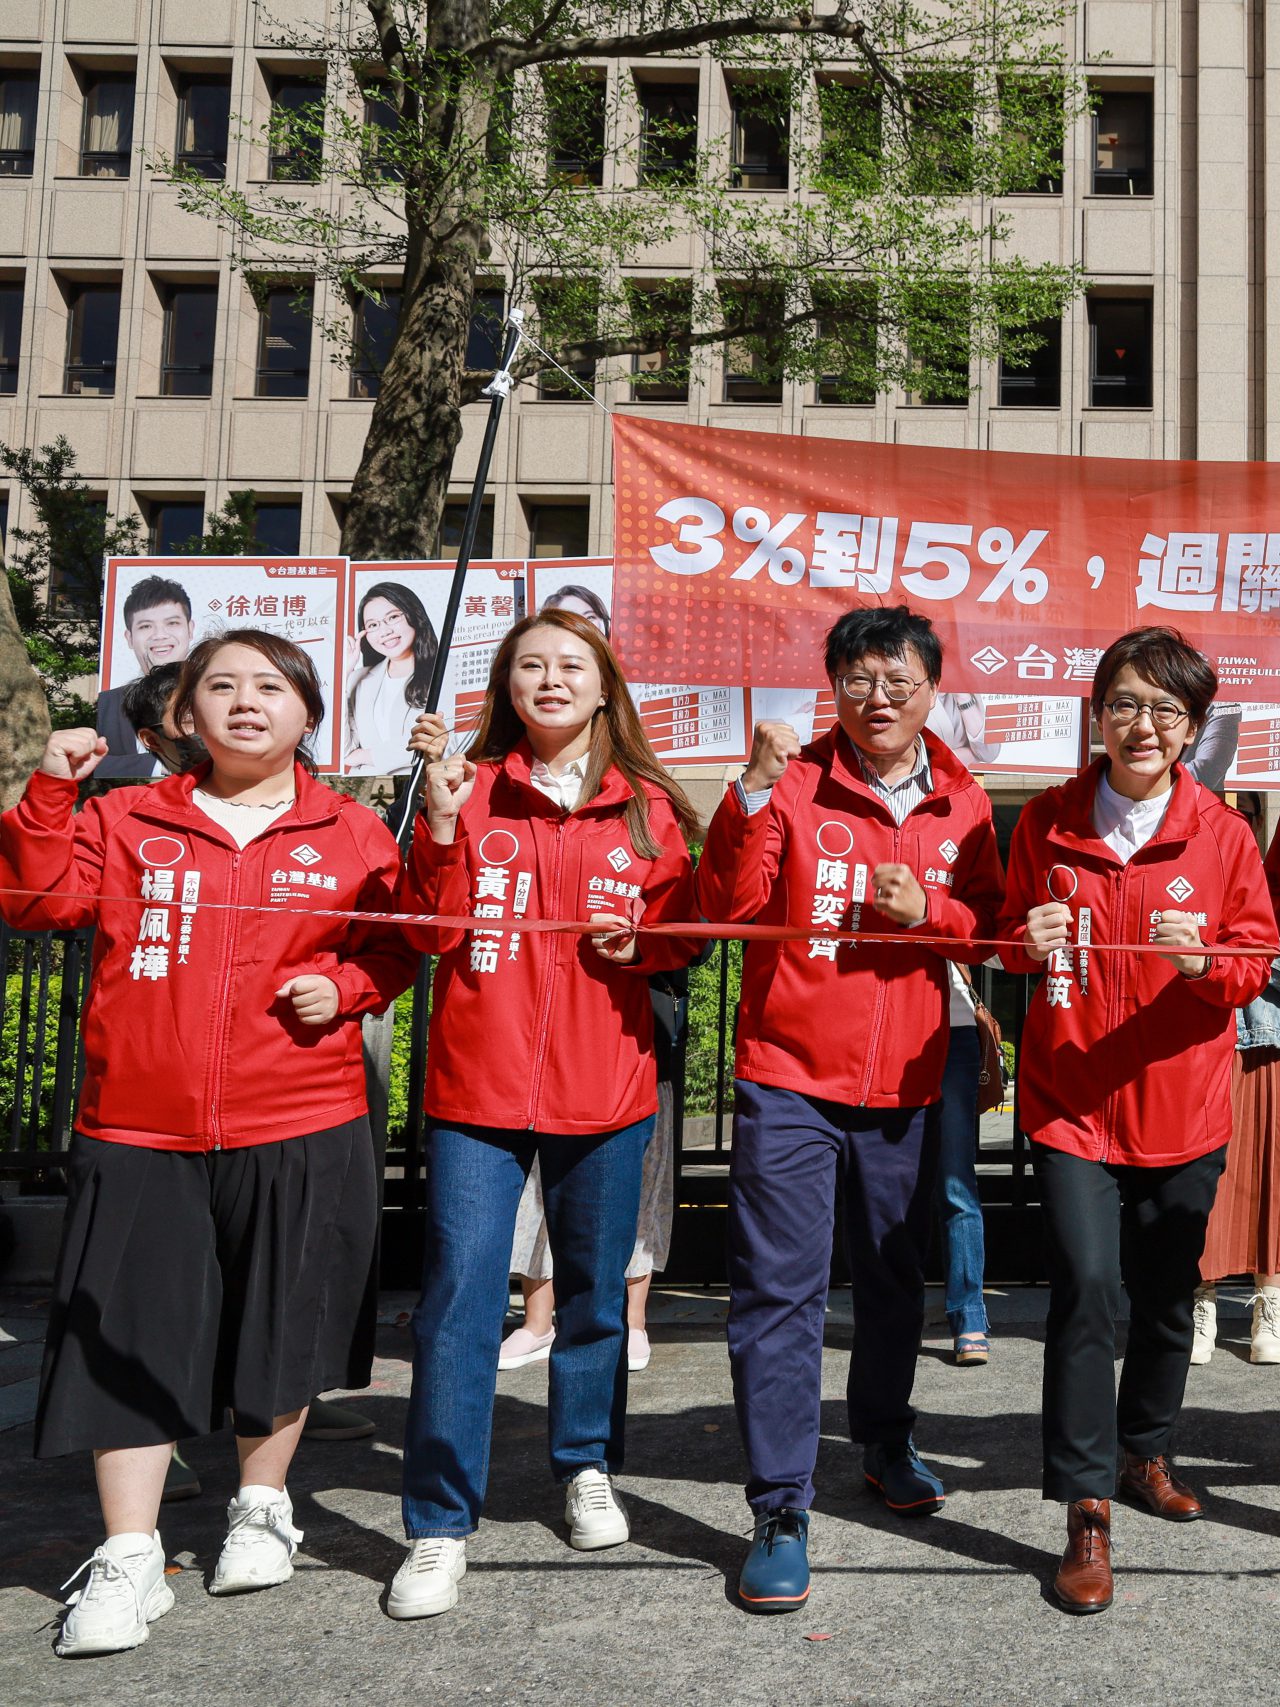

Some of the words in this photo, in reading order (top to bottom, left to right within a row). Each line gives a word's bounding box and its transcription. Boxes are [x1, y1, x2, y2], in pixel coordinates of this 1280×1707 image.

[277, 566, 318, 576] 台灣基進
[226, 595, 307, 617] 徐煊博
[1217, 656, 1257, 665] TAIWAN
[1218, 677, 1254, 685] PARTY
[712, 690, 727, 700] MAX
[712, 703, 727, 713] MAX
[1056, 700, 1070, 710] MAX
[712, 717, 727, 727] MAX
[1055, 714, 1069, 723] MAX
[713, 730, 728, 741] MAX
[1054, 728, 1068, 737] MAX
[270, 869, 338, 891] 台灣基進
[588, 876, 642, 899] 台灣基進
[129, 869, 175, 981] 楊佩樺
